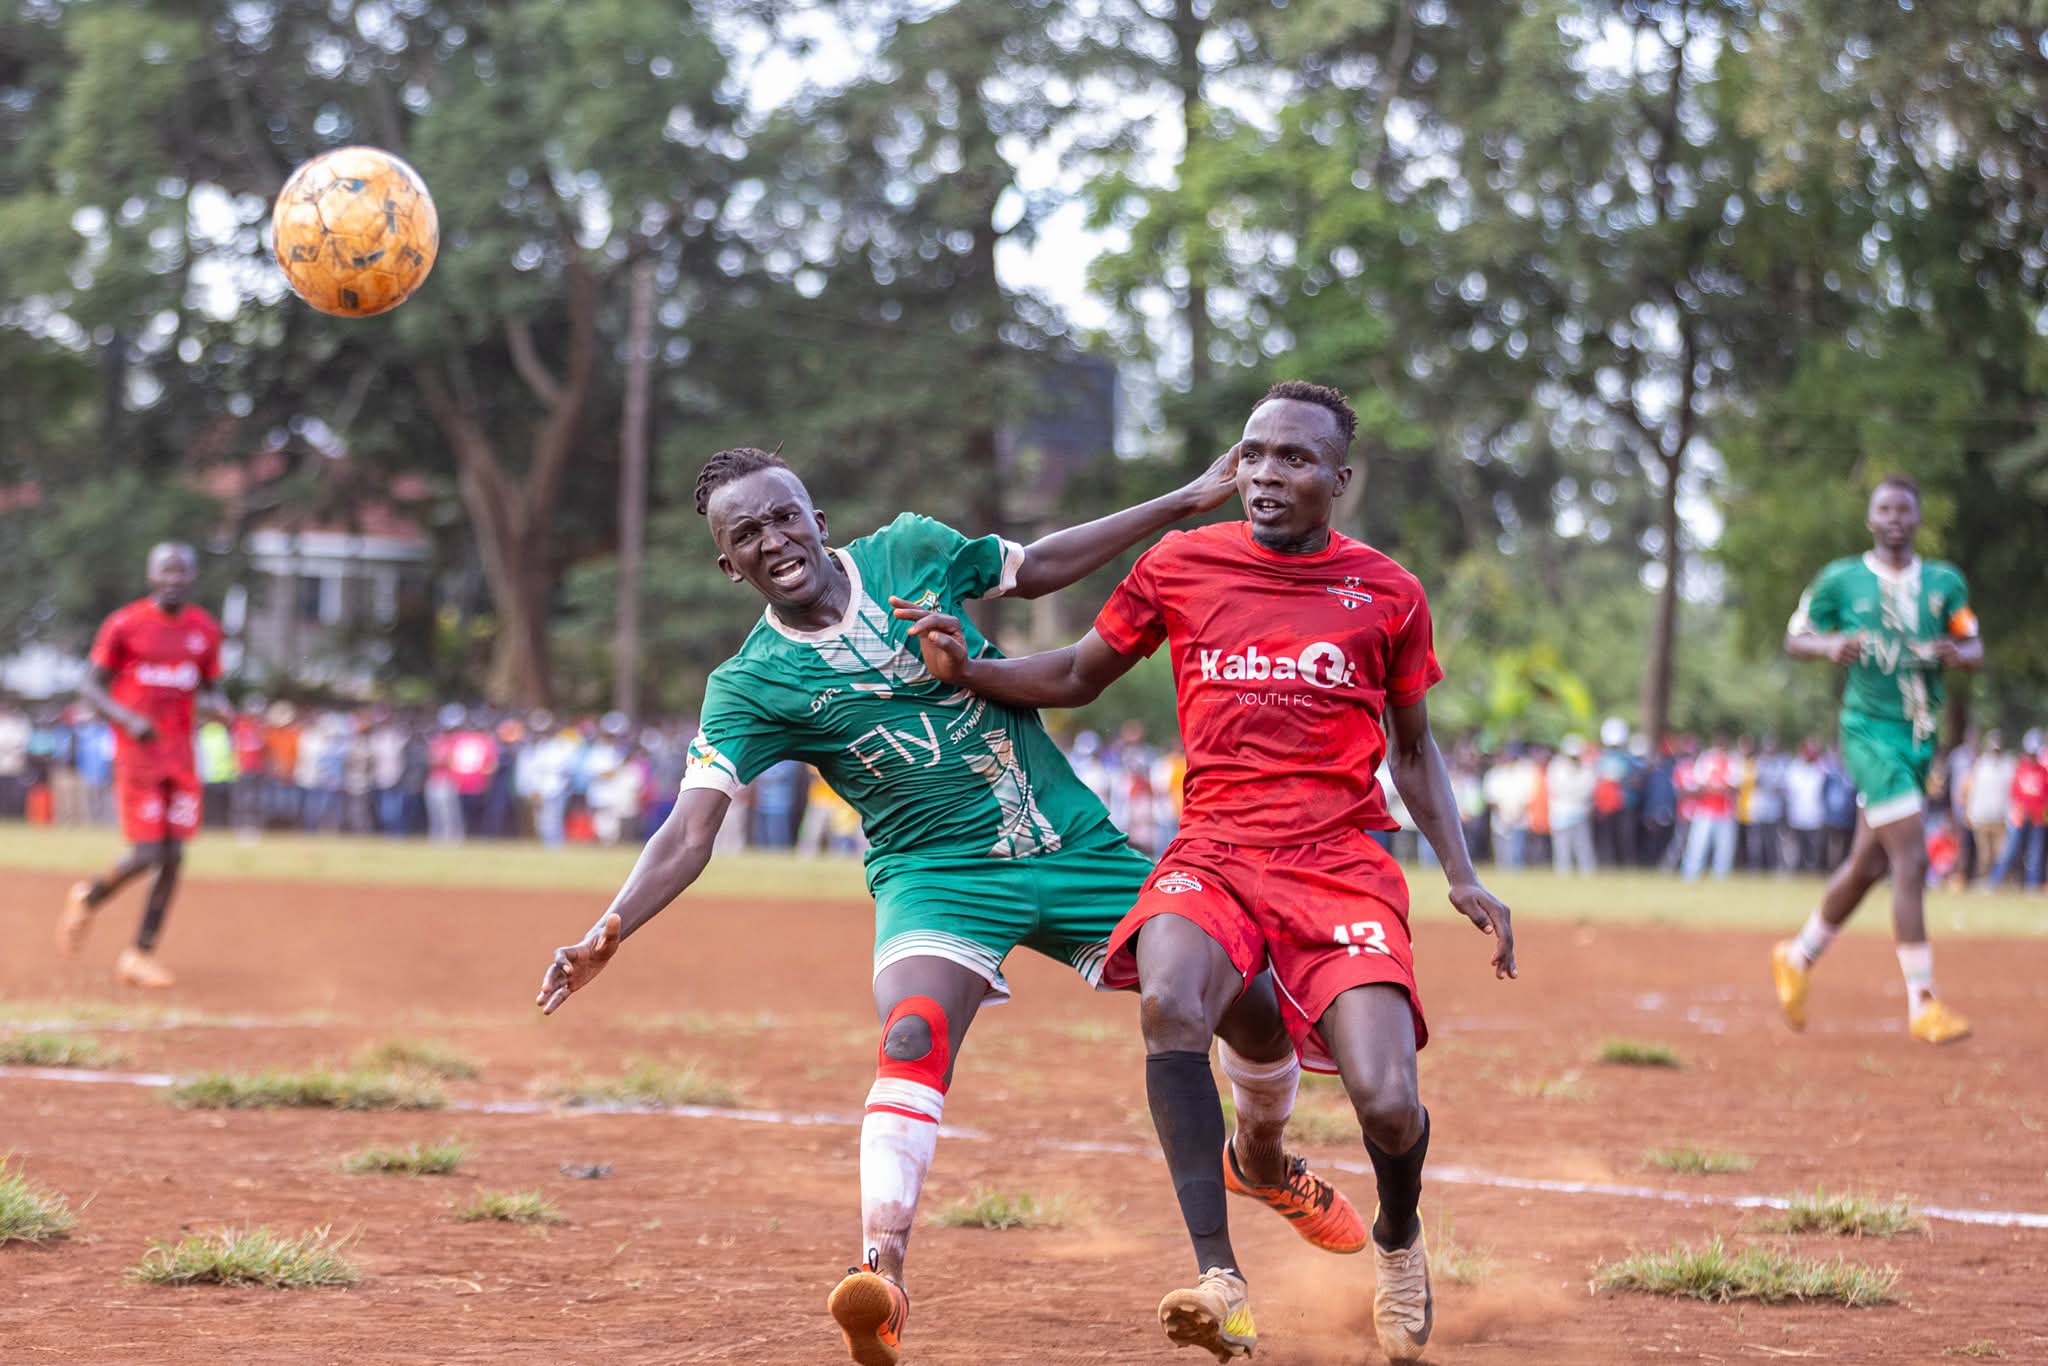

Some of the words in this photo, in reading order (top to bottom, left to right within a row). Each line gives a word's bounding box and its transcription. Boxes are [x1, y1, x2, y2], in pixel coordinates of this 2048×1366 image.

[1236, 692, 1289, 706] YOUTH
[1293, 694, 1313, 707] FC
[950, 697, 986, 744] SKYWAR
[1333, 921, 1391, 957] 13
